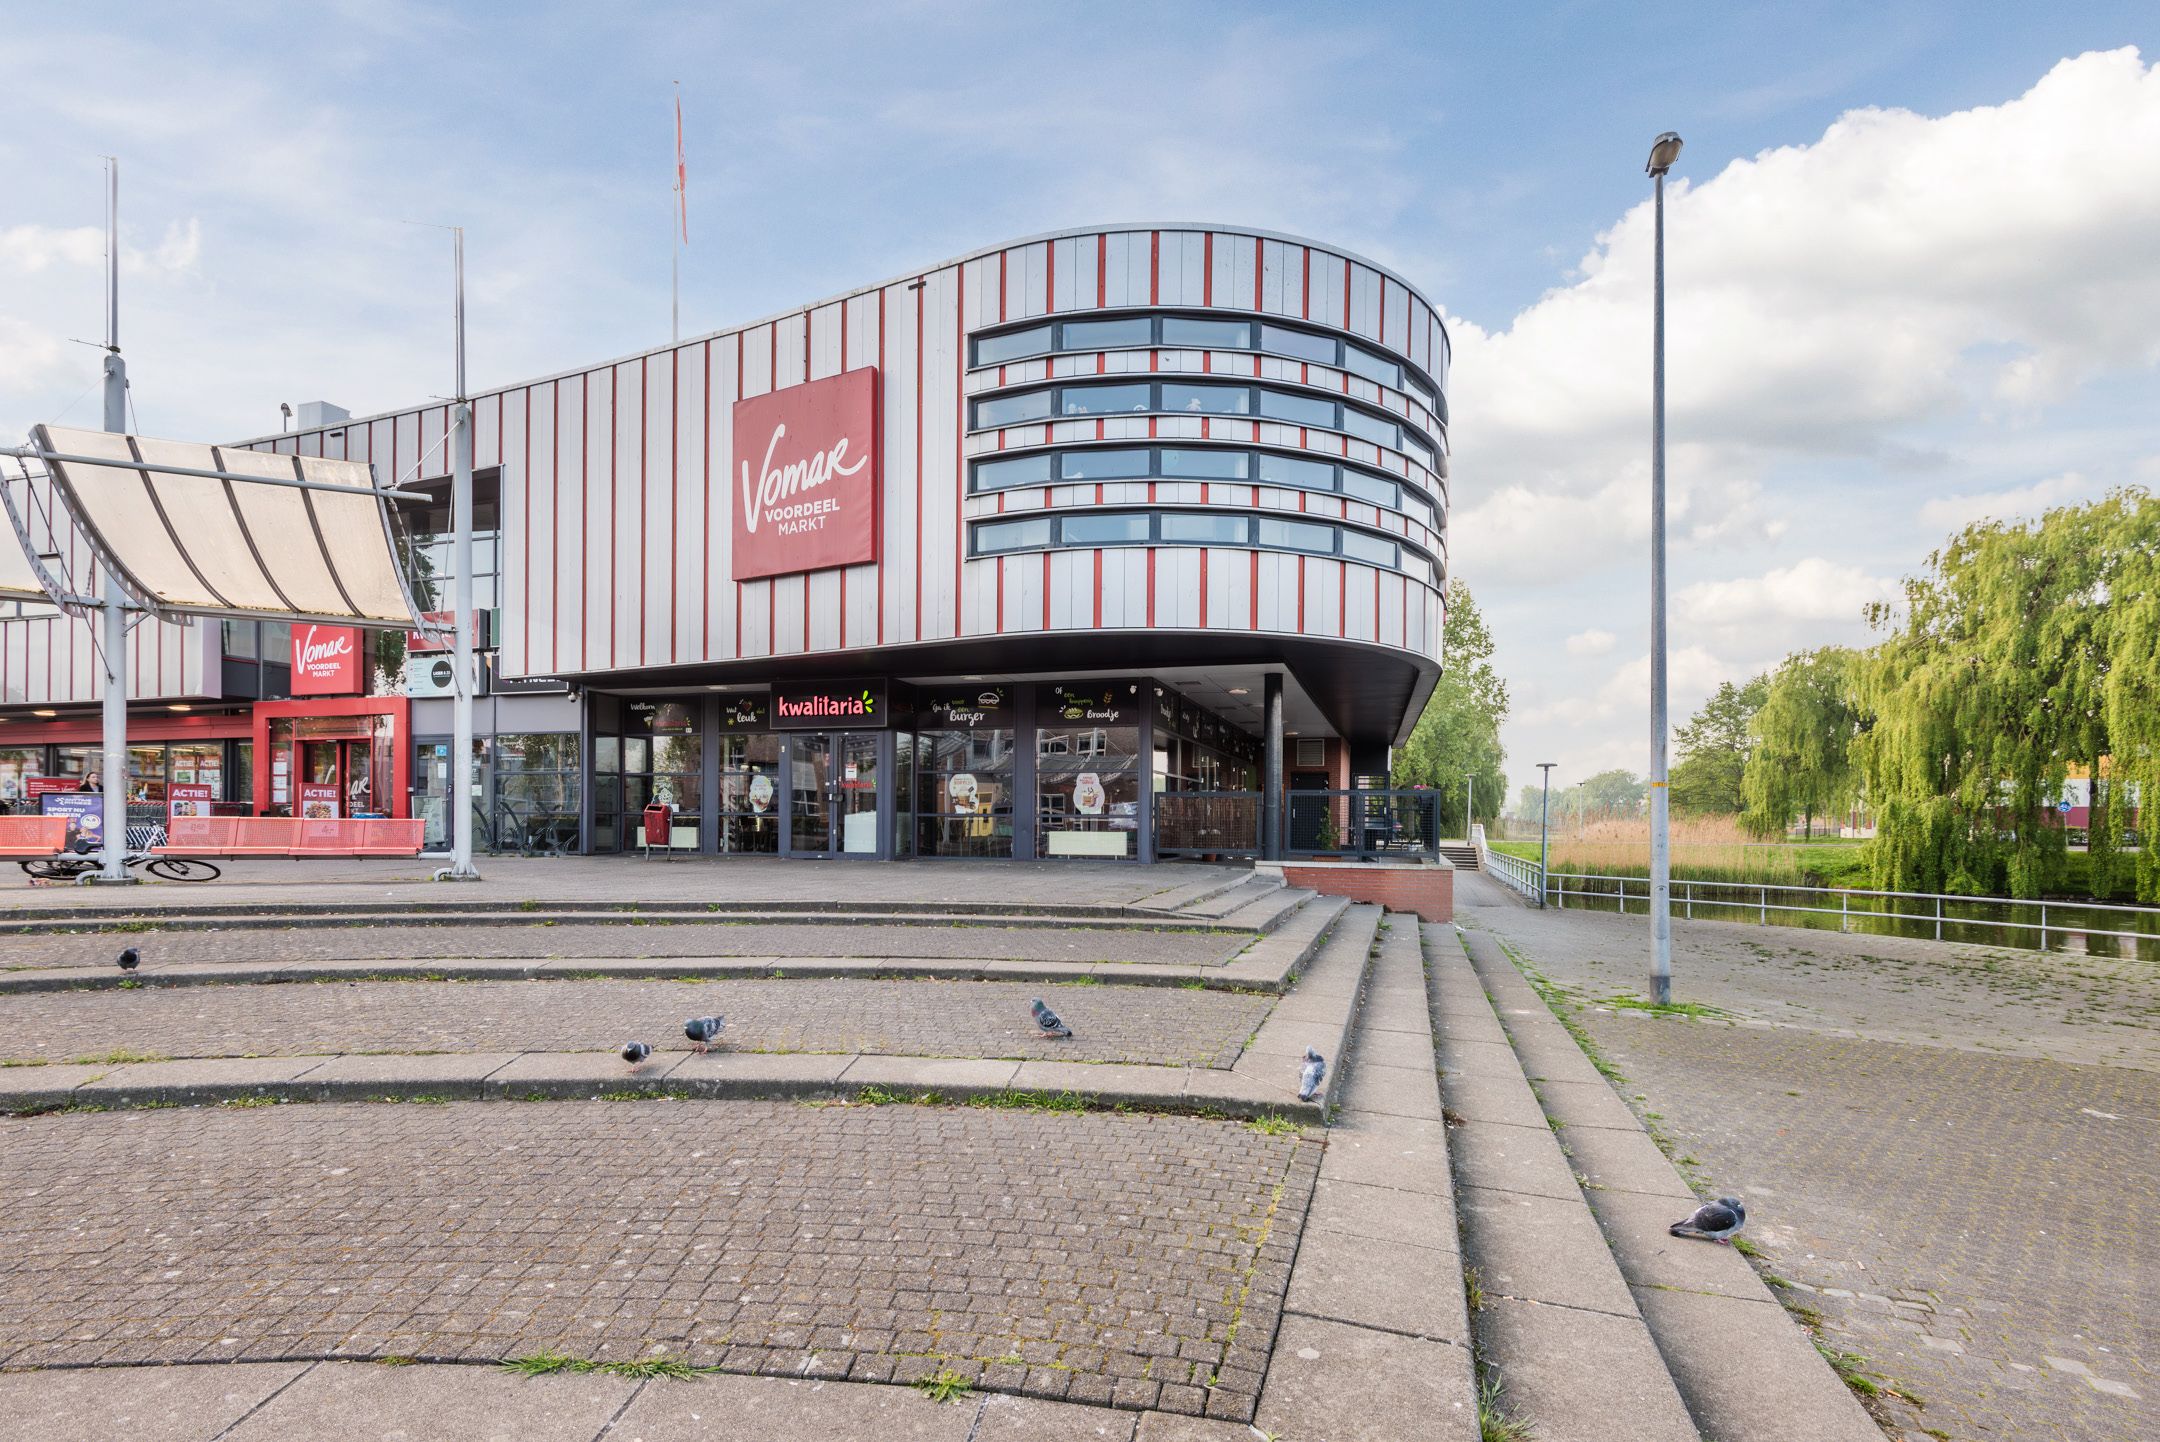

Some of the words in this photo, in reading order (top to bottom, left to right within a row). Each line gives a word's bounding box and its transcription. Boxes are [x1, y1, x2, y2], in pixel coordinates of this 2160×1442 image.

[742, 423, 868, 533] Vomar
[765, 498, 840, 523] VOORDEEL
[778, 516, 826, 536] MARKT
[295, 625, 353, 674] Vomar
[306, 662, 341, 671] VOORDEEL
[312, 669, 335, 678] MARKT
[779, 695, 864, 717] kwalitaria
[736, 711, 757, 723] leuk
[949, 709, 984, 727] Burger
[1086, 708, 1119, 722] Broodje
[172, 789, 208, 798] ACTIE!
[304, 789, 336, 798] ACTIE!
